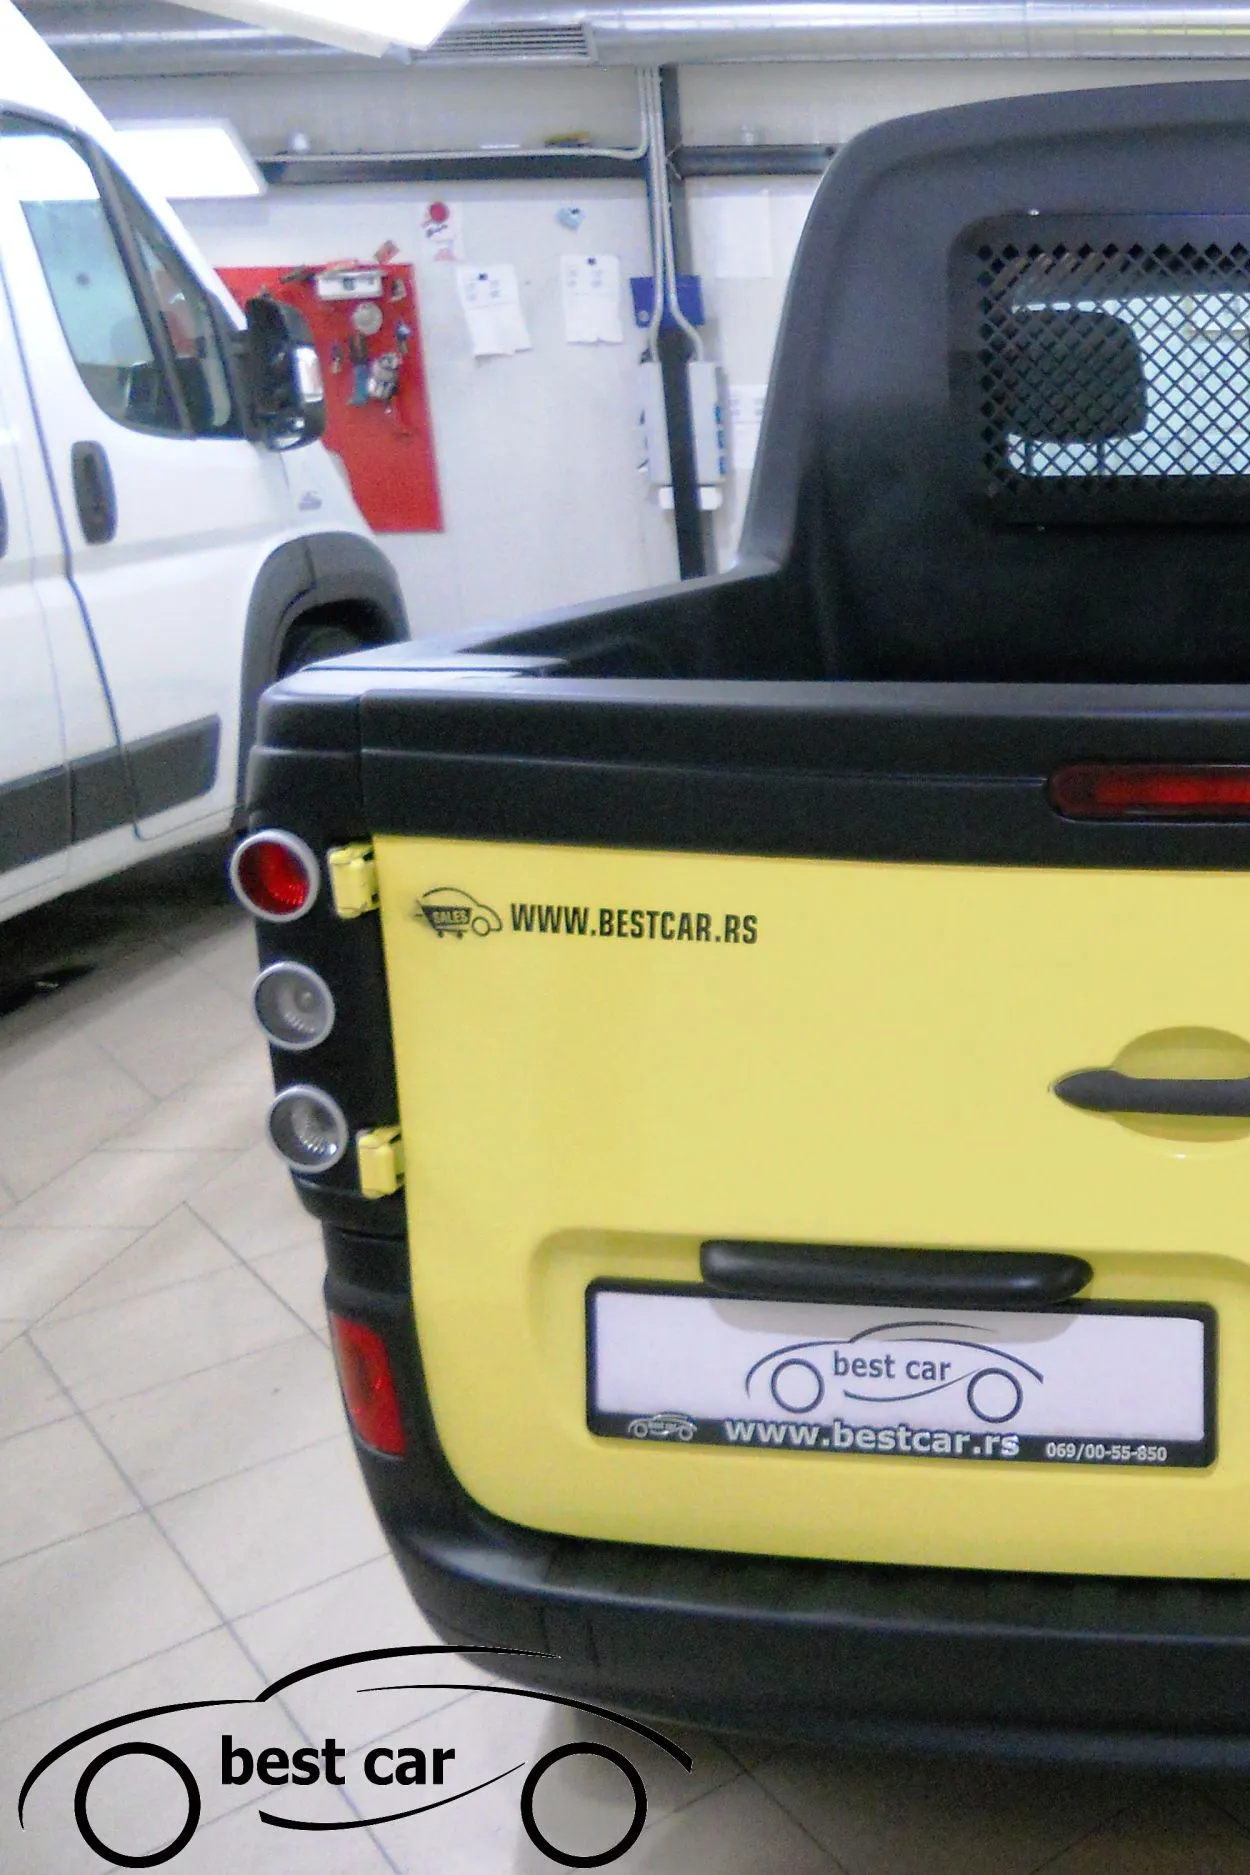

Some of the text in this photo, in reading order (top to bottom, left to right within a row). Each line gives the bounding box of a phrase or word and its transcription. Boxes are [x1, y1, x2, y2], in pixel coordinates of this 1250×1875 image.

[511, 902, 758, 944] WWW.BESTCAR.RS
[833, 1350, 951, 1382] best car
[725, 1417, 1021, 1458] www.bestcar.rs
[1045, 1442, 1168, 1463] 069/00-55-850
